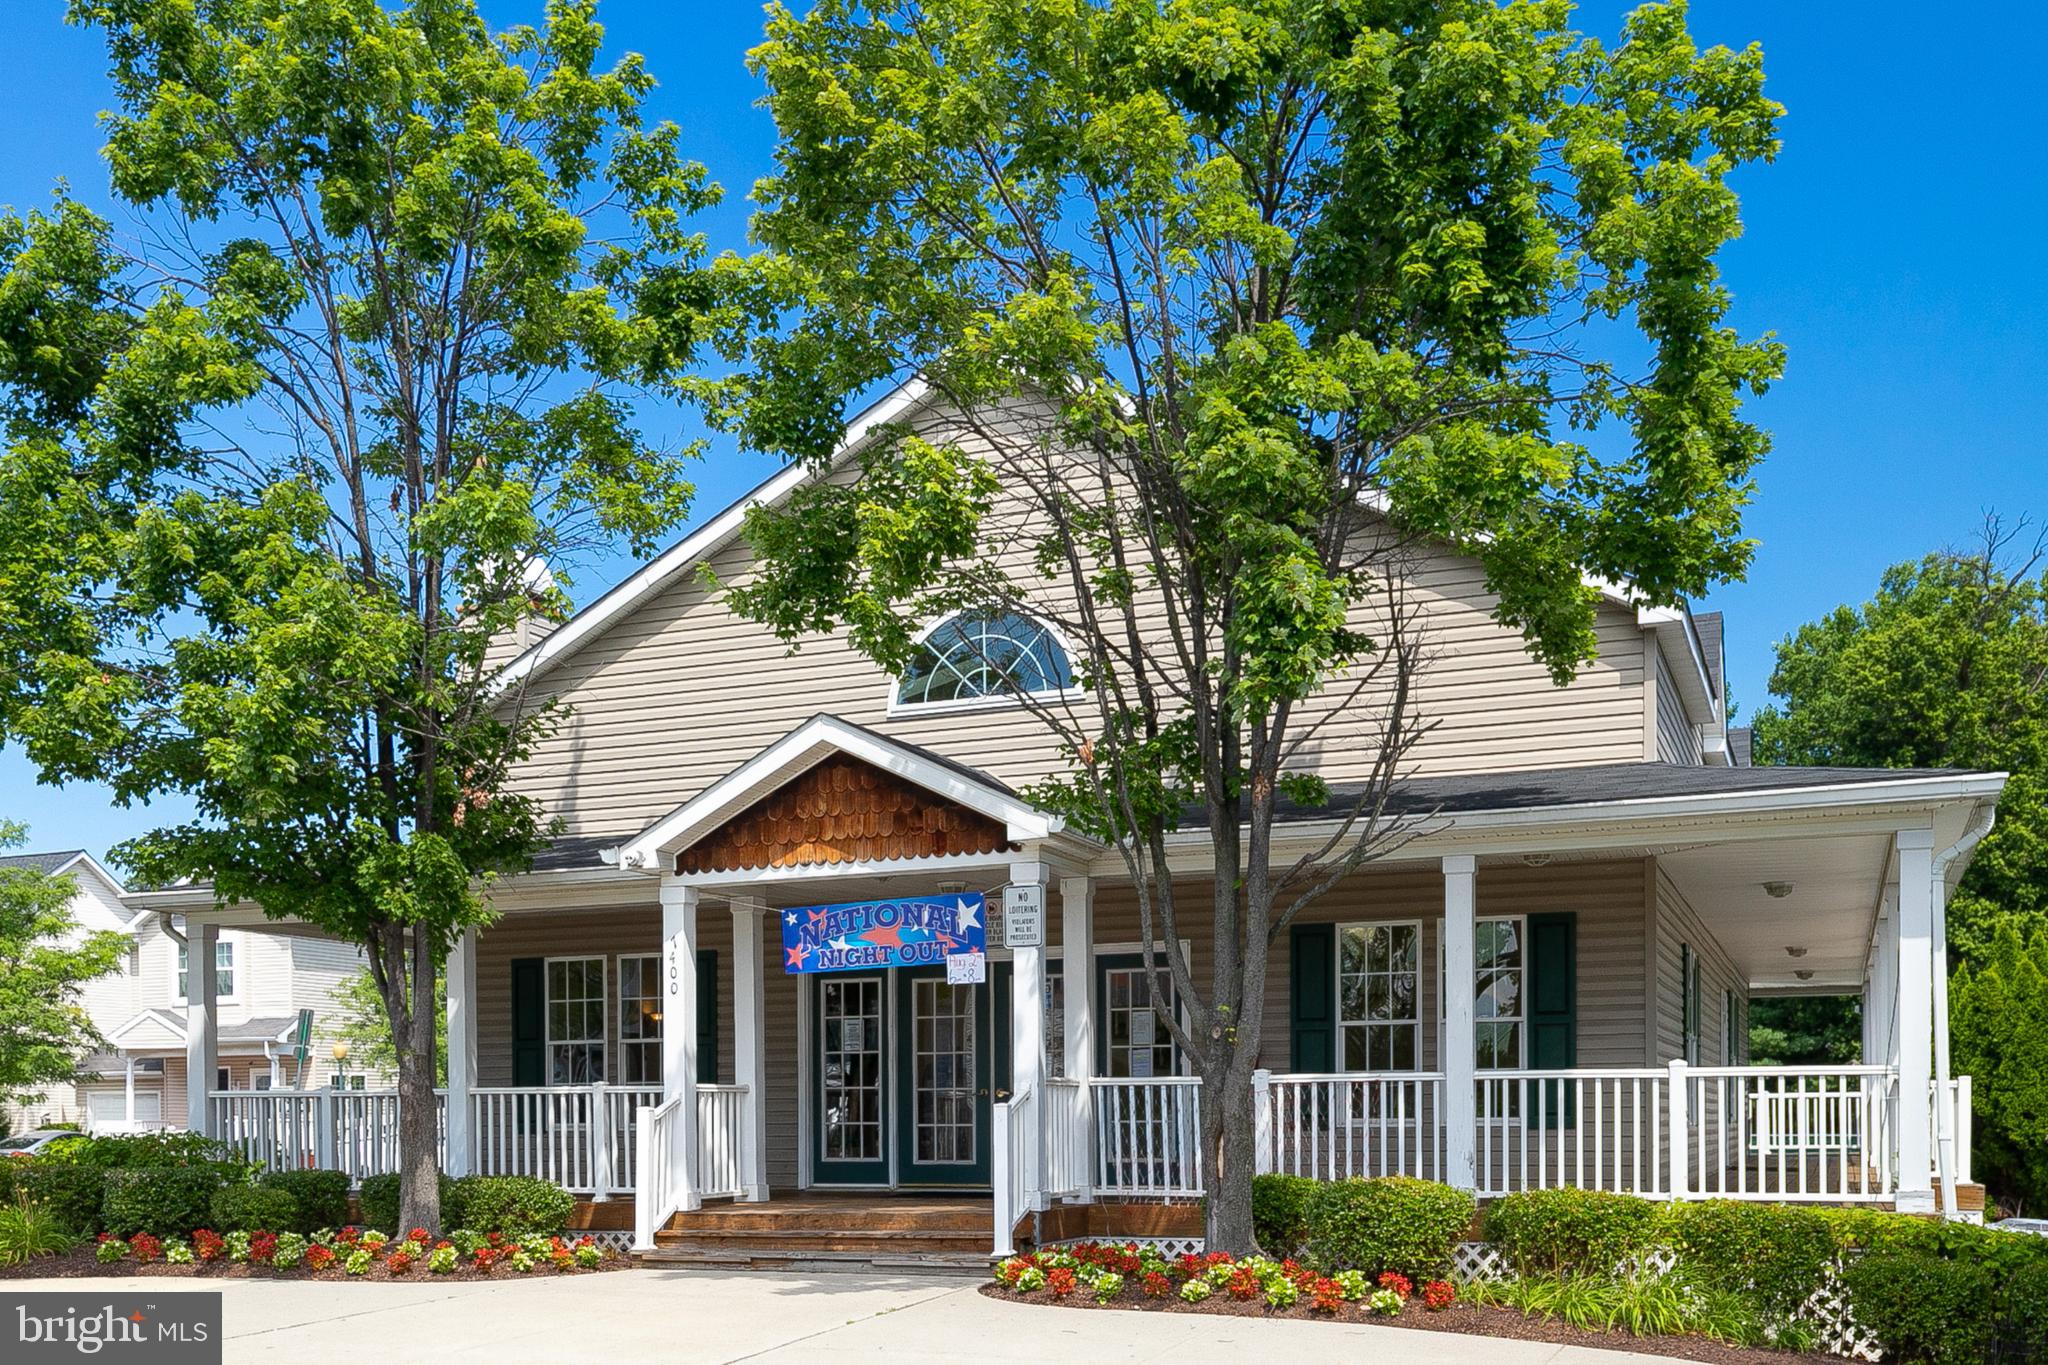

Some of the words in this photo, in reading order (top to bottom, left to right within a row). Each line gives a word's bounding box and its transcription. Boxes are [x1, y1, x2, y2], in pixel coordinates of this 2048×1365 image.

[1018, 892, 1028, 902] NO
[1009, 905, 1038, 914] LOITERING
[800, 902, 968, 953] NATIONAL
[818, 944, 894, 969] NIGHT
[900, 941, 949, 962] OUT
